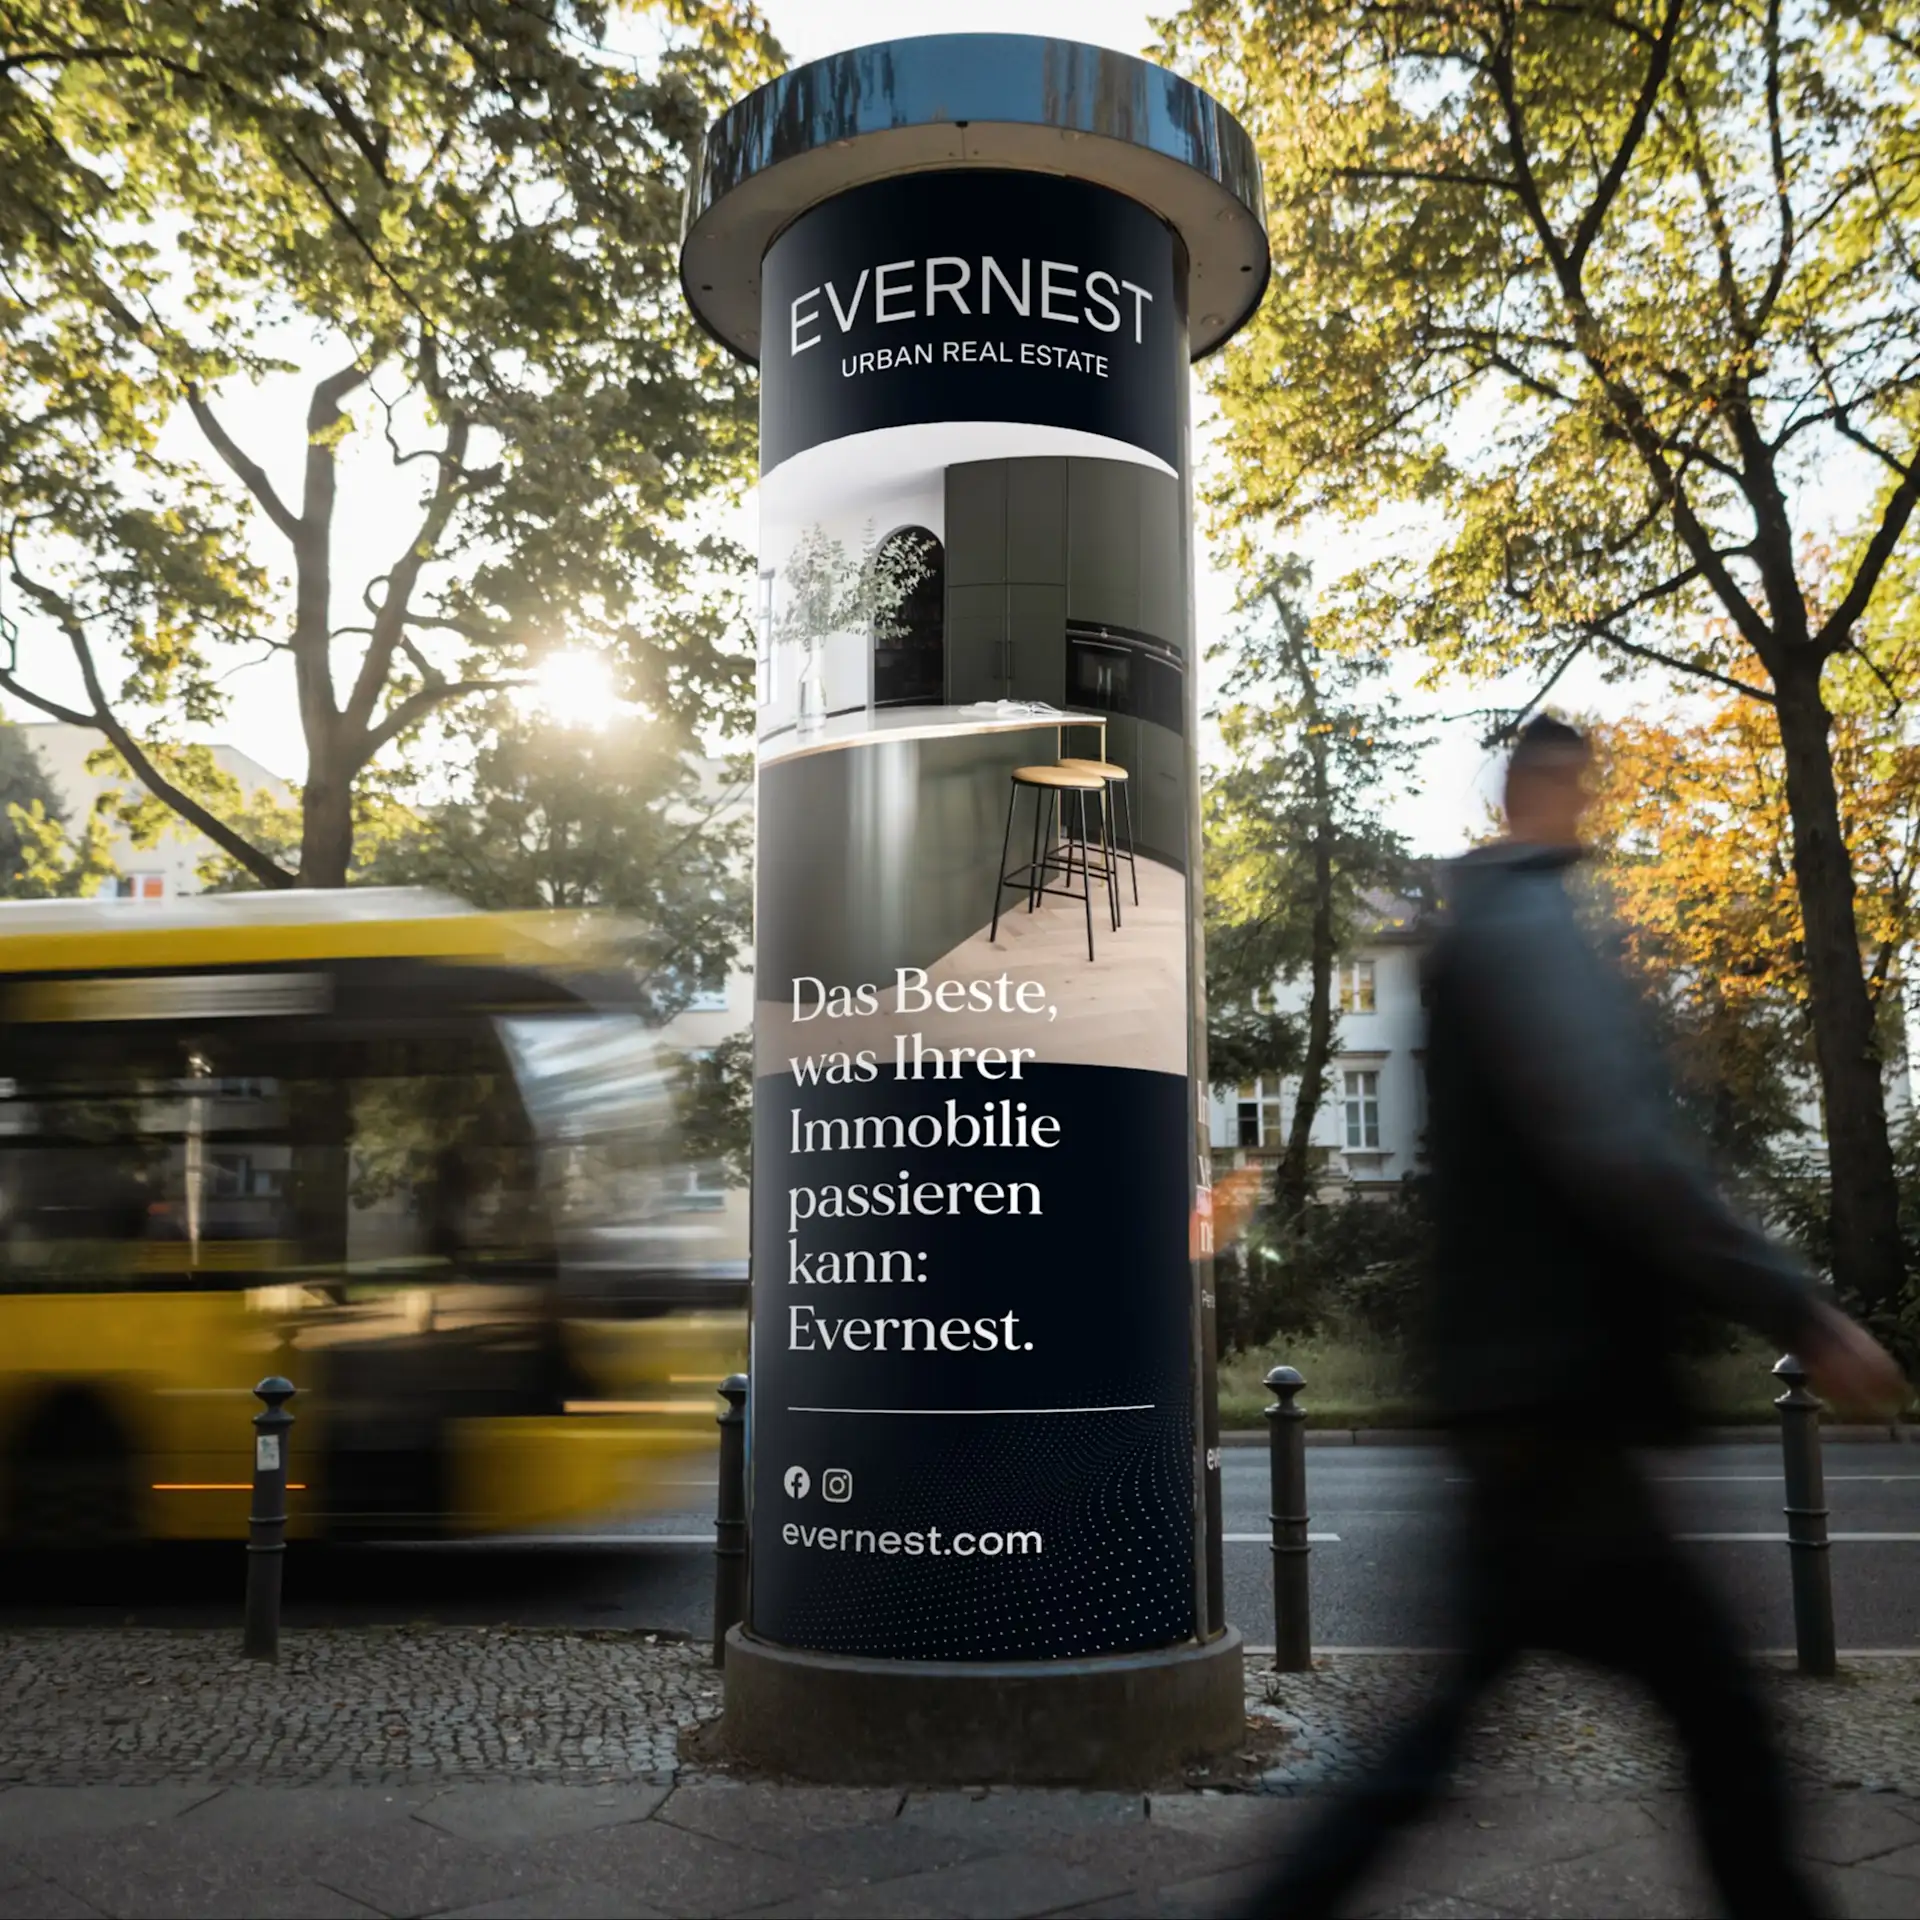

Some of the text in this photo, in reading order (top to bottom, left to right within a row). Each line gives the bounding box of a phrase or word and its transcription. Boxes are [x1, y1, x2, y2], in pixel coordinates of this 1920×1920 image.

[790, 255, 1153, 357] EVERNEST
[841, 340, 1109, 378] URBAN REAL ESTATE
[792, 967, 1058, 1023] Das Beste,
[788, 1032, 1036, 1087] was Ihrer
[789, 1098, 1061, 1154] Immobilie
[787, 1169, 1043, 1234] passieren
[787, 1237, 928, 1285] kann:
[787, 1305, 1034, 1352] Evernest.
[782, 1523, 1042, 1556] evernest.com
